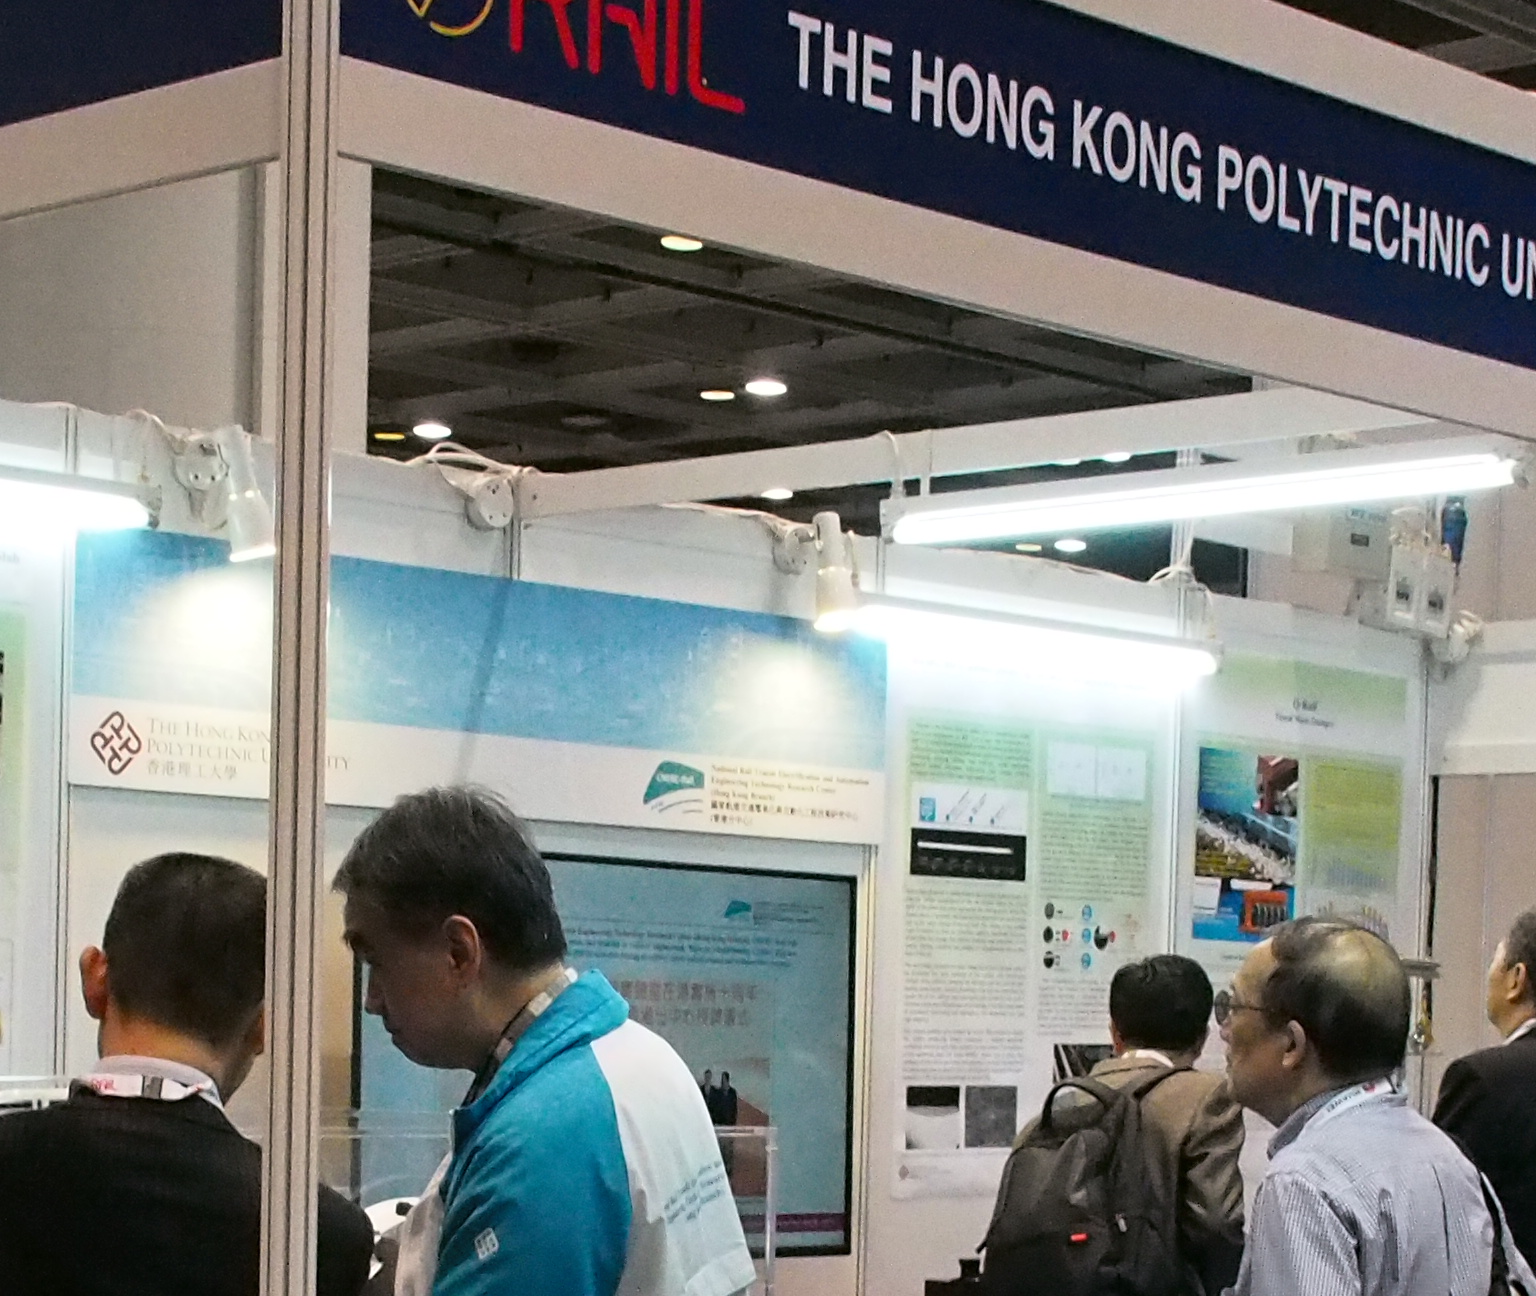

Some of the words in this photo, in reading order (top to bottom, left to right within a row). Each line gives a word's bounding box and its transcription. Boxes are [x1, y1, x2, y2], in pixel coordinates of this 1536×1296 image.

[788, 10, 893, 115] THE
[911, 49, 1055, 161] HONG
[1072, 99, 1202, 204] KONG
[1217, 144, 1490, 288] POLYTECHNIC
[147, 718, 180, 736] THE
[184, 722, 233, 742] HONG
[147, 737, 255, 763] POLYTECHNIC
